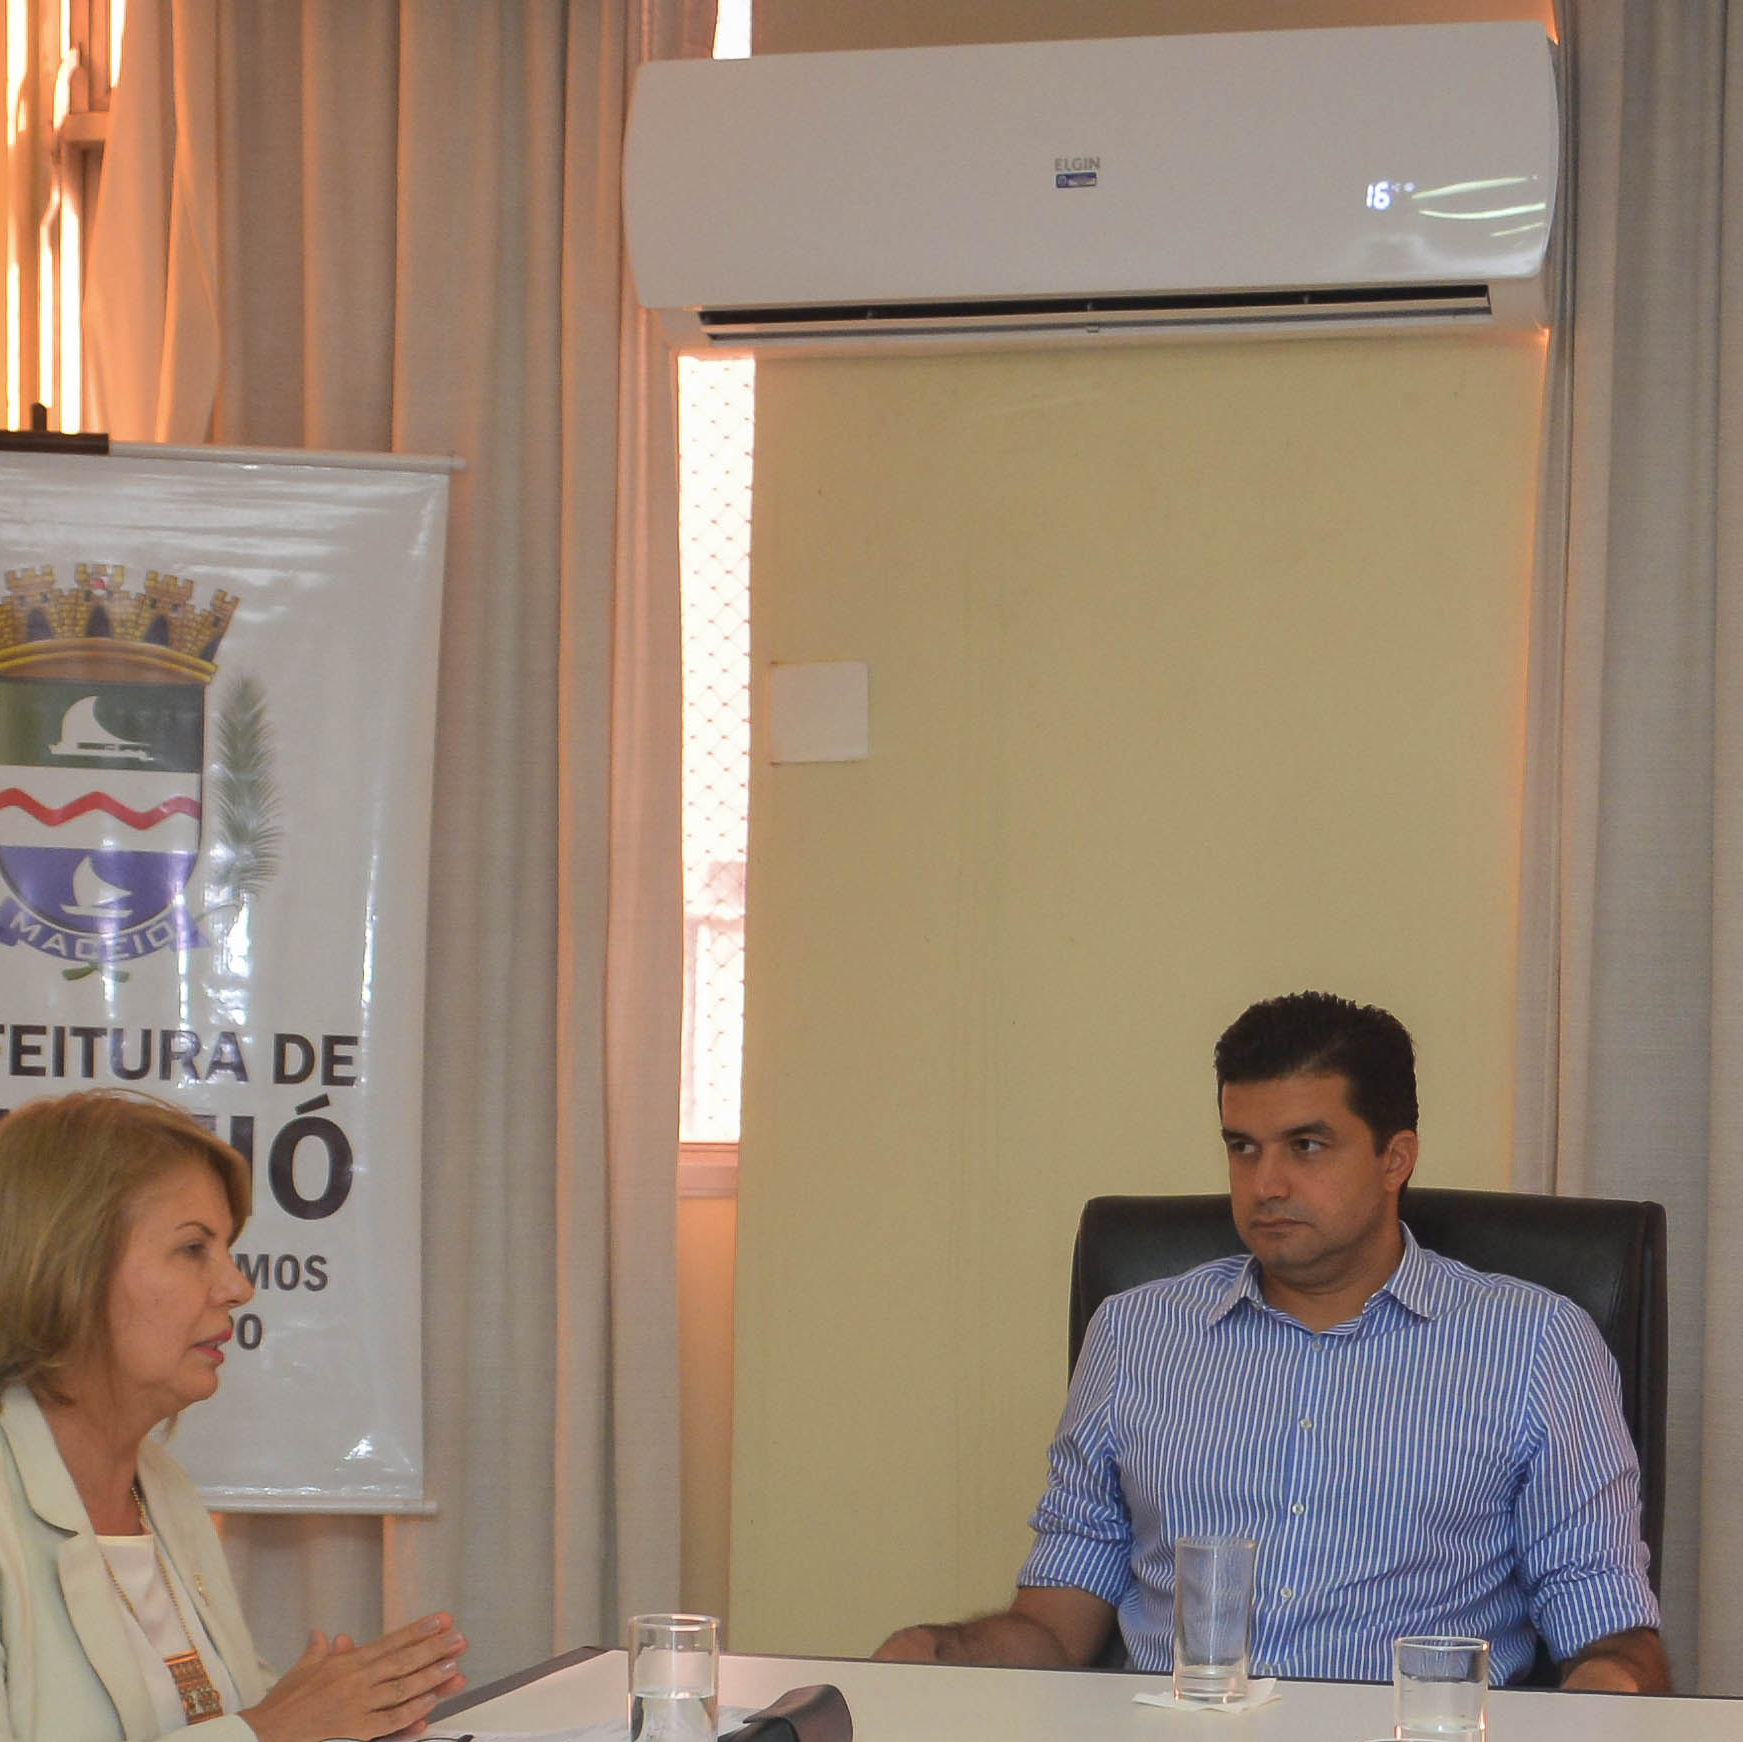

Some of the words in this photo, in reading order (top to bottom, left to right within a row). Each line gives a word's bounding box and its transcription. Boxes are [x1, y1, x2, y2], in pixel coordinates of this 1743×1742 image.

[1054, 156, 1101, 171] ELGIN
[1365, 180, 1391, 211] 16
[273, 1032, 358, 1086] DE
